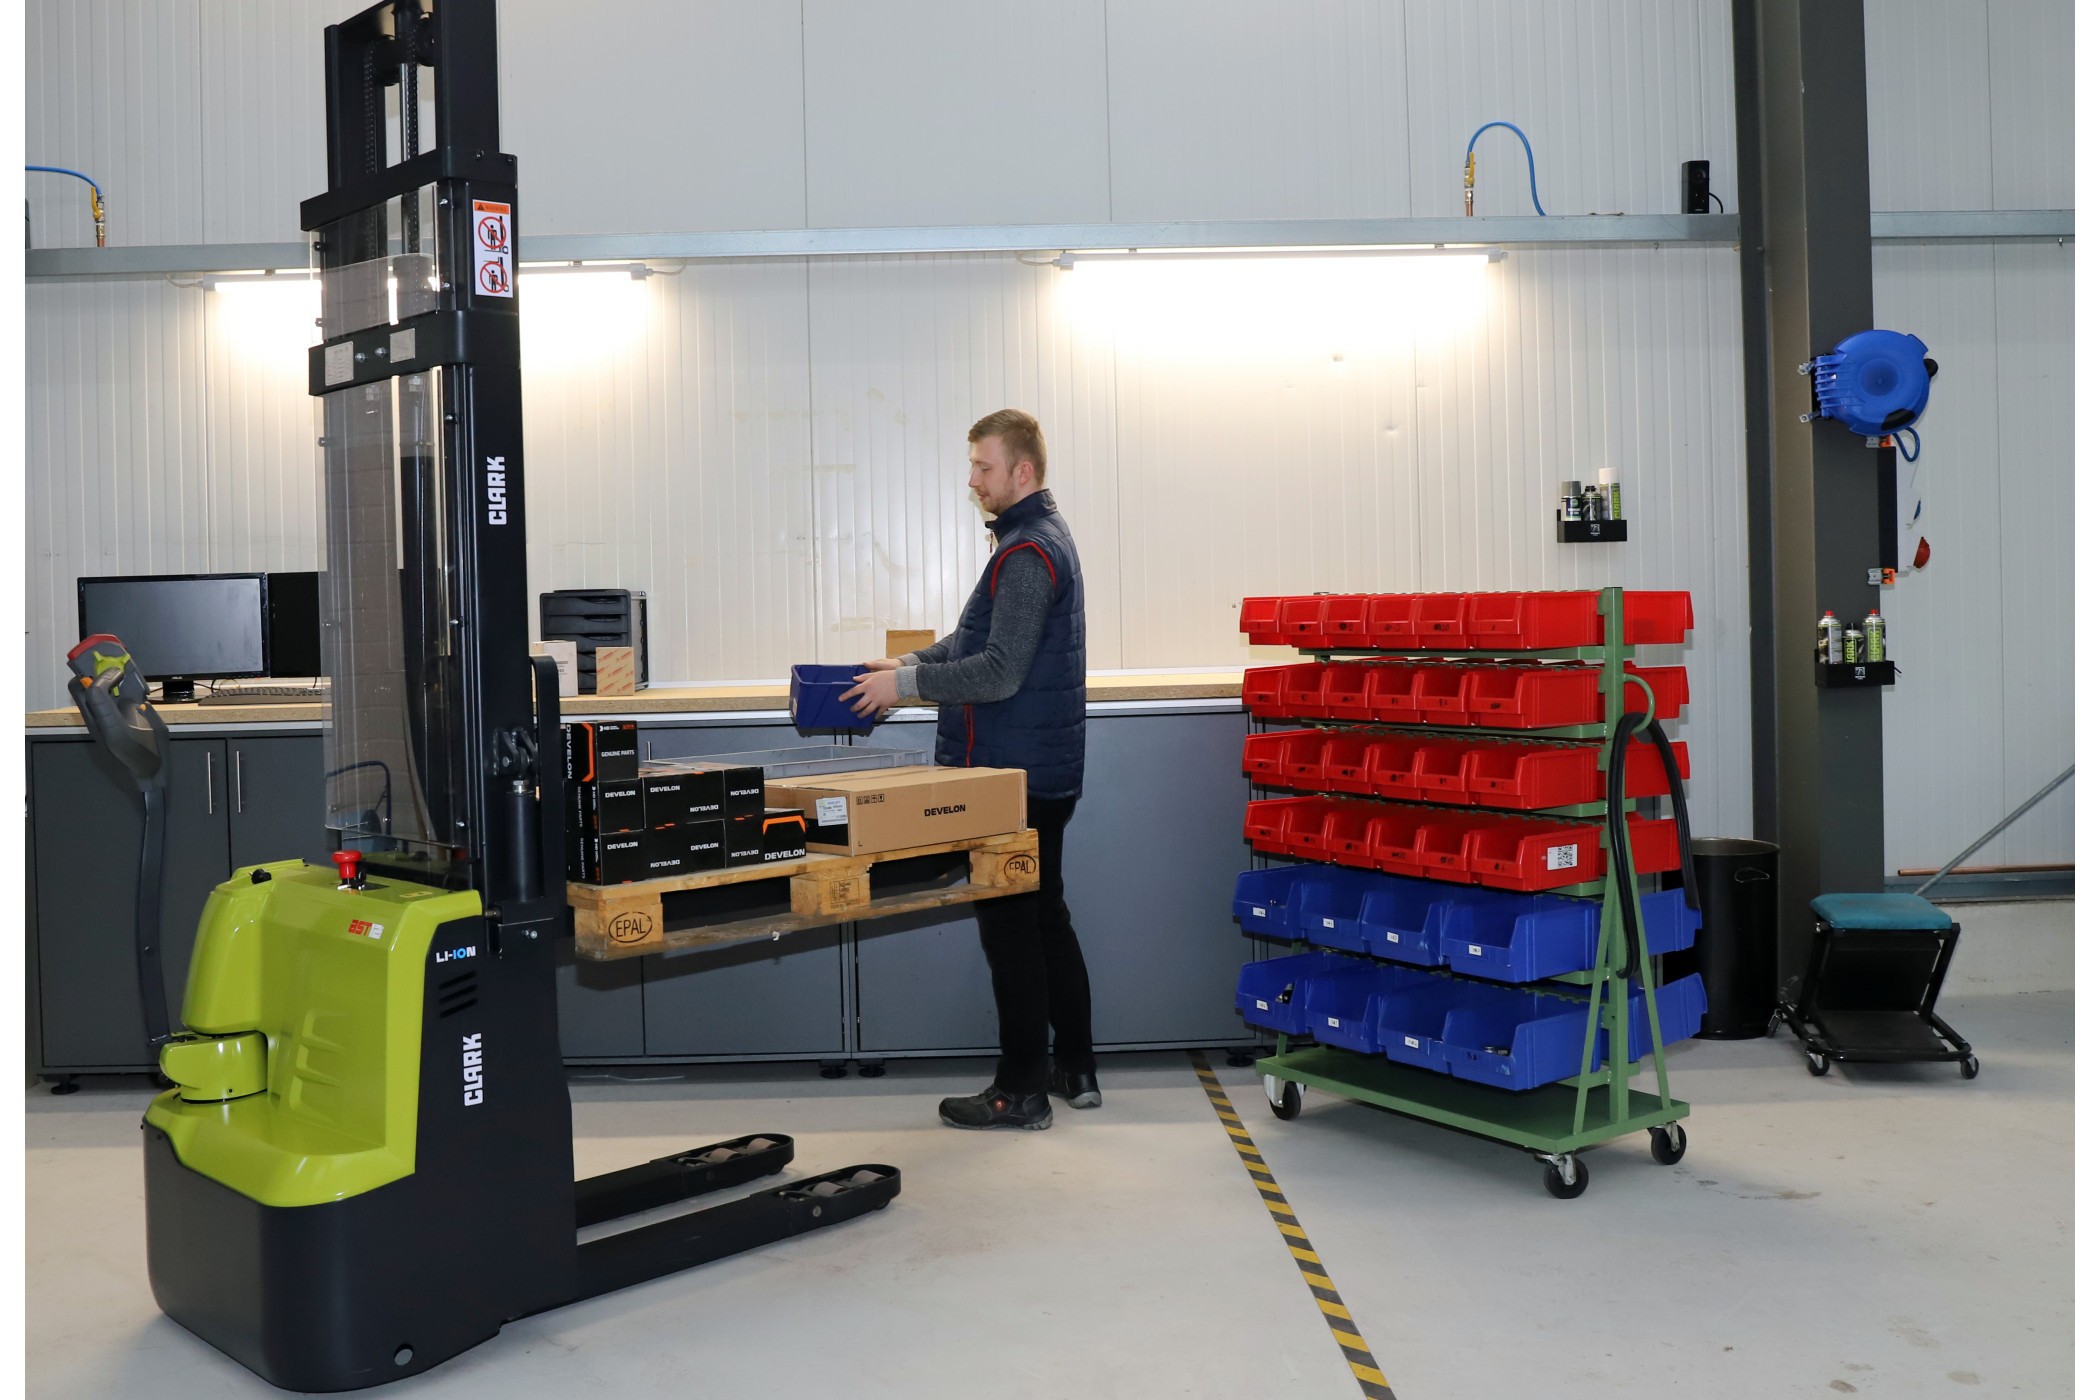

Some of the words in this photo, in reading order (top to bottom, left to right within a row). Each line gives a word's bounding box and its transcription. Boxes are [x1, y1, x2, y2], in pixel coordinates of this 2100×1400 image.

[486, 456, 507, 525] CLARK
[650, 785, 680, 793] DEVELON
[730, 788, 760, 796] DEVELON
[605, 790, 636, 798] DEVELON
[690, 804, 719, 813] DEVELON
[924, 804, 966, 817] DEVELON
[607, 841, 639, 850] DEVELON
[690, 842, 719, 851] DEVELON
[731, 849, 759, 858] DEVELON
[764, 848, 806, 861] DEVELON
[650, 859, 681, 868] DEVELON
[1009, 860, 1032, 874] EPAL
[615, 918, 647, 938] EPAL
[436, 946, 476, 963] LI-ION
[463, 1033, 483, 1106] CLARK
